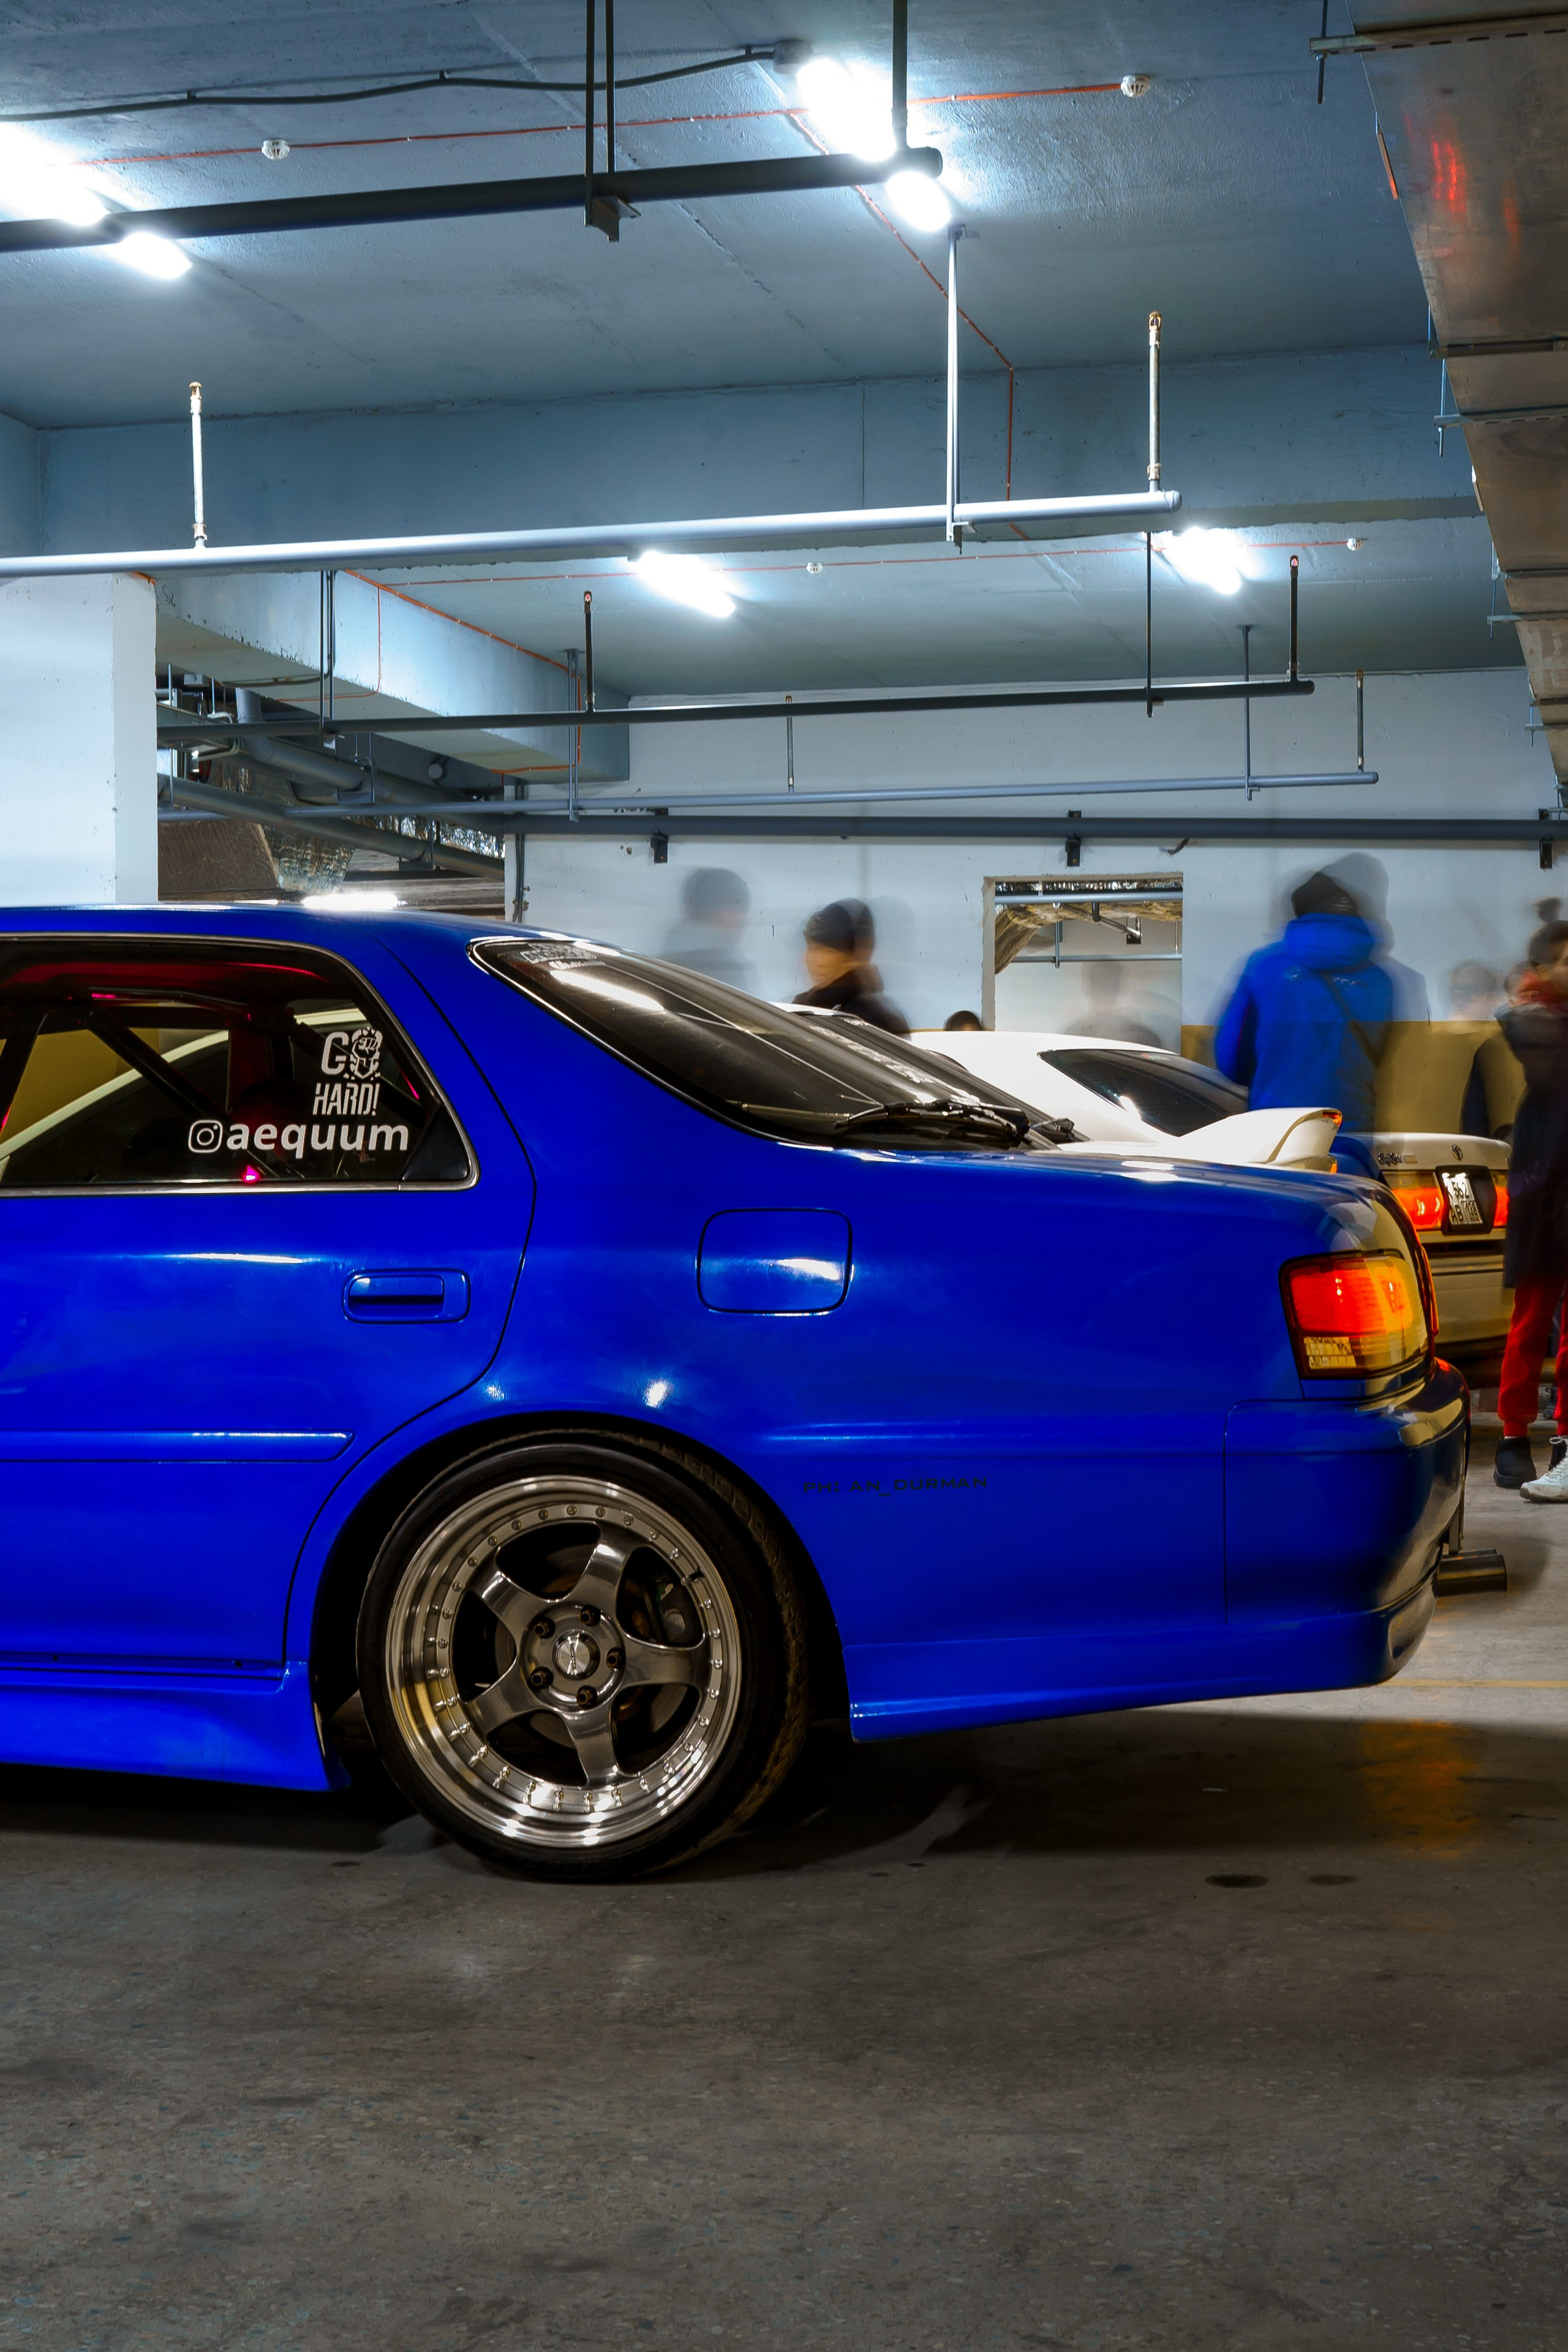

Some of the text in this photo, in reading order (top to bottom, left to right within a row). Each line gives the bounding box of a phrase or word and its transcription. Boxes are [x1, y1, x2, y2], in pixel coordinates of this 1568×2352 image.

[312, 1082, 380, 1115] HARD!
[227, 1123, 409, 1159] aequum
[803, 1477, 987, 1496] PH: AN_DURMAN
